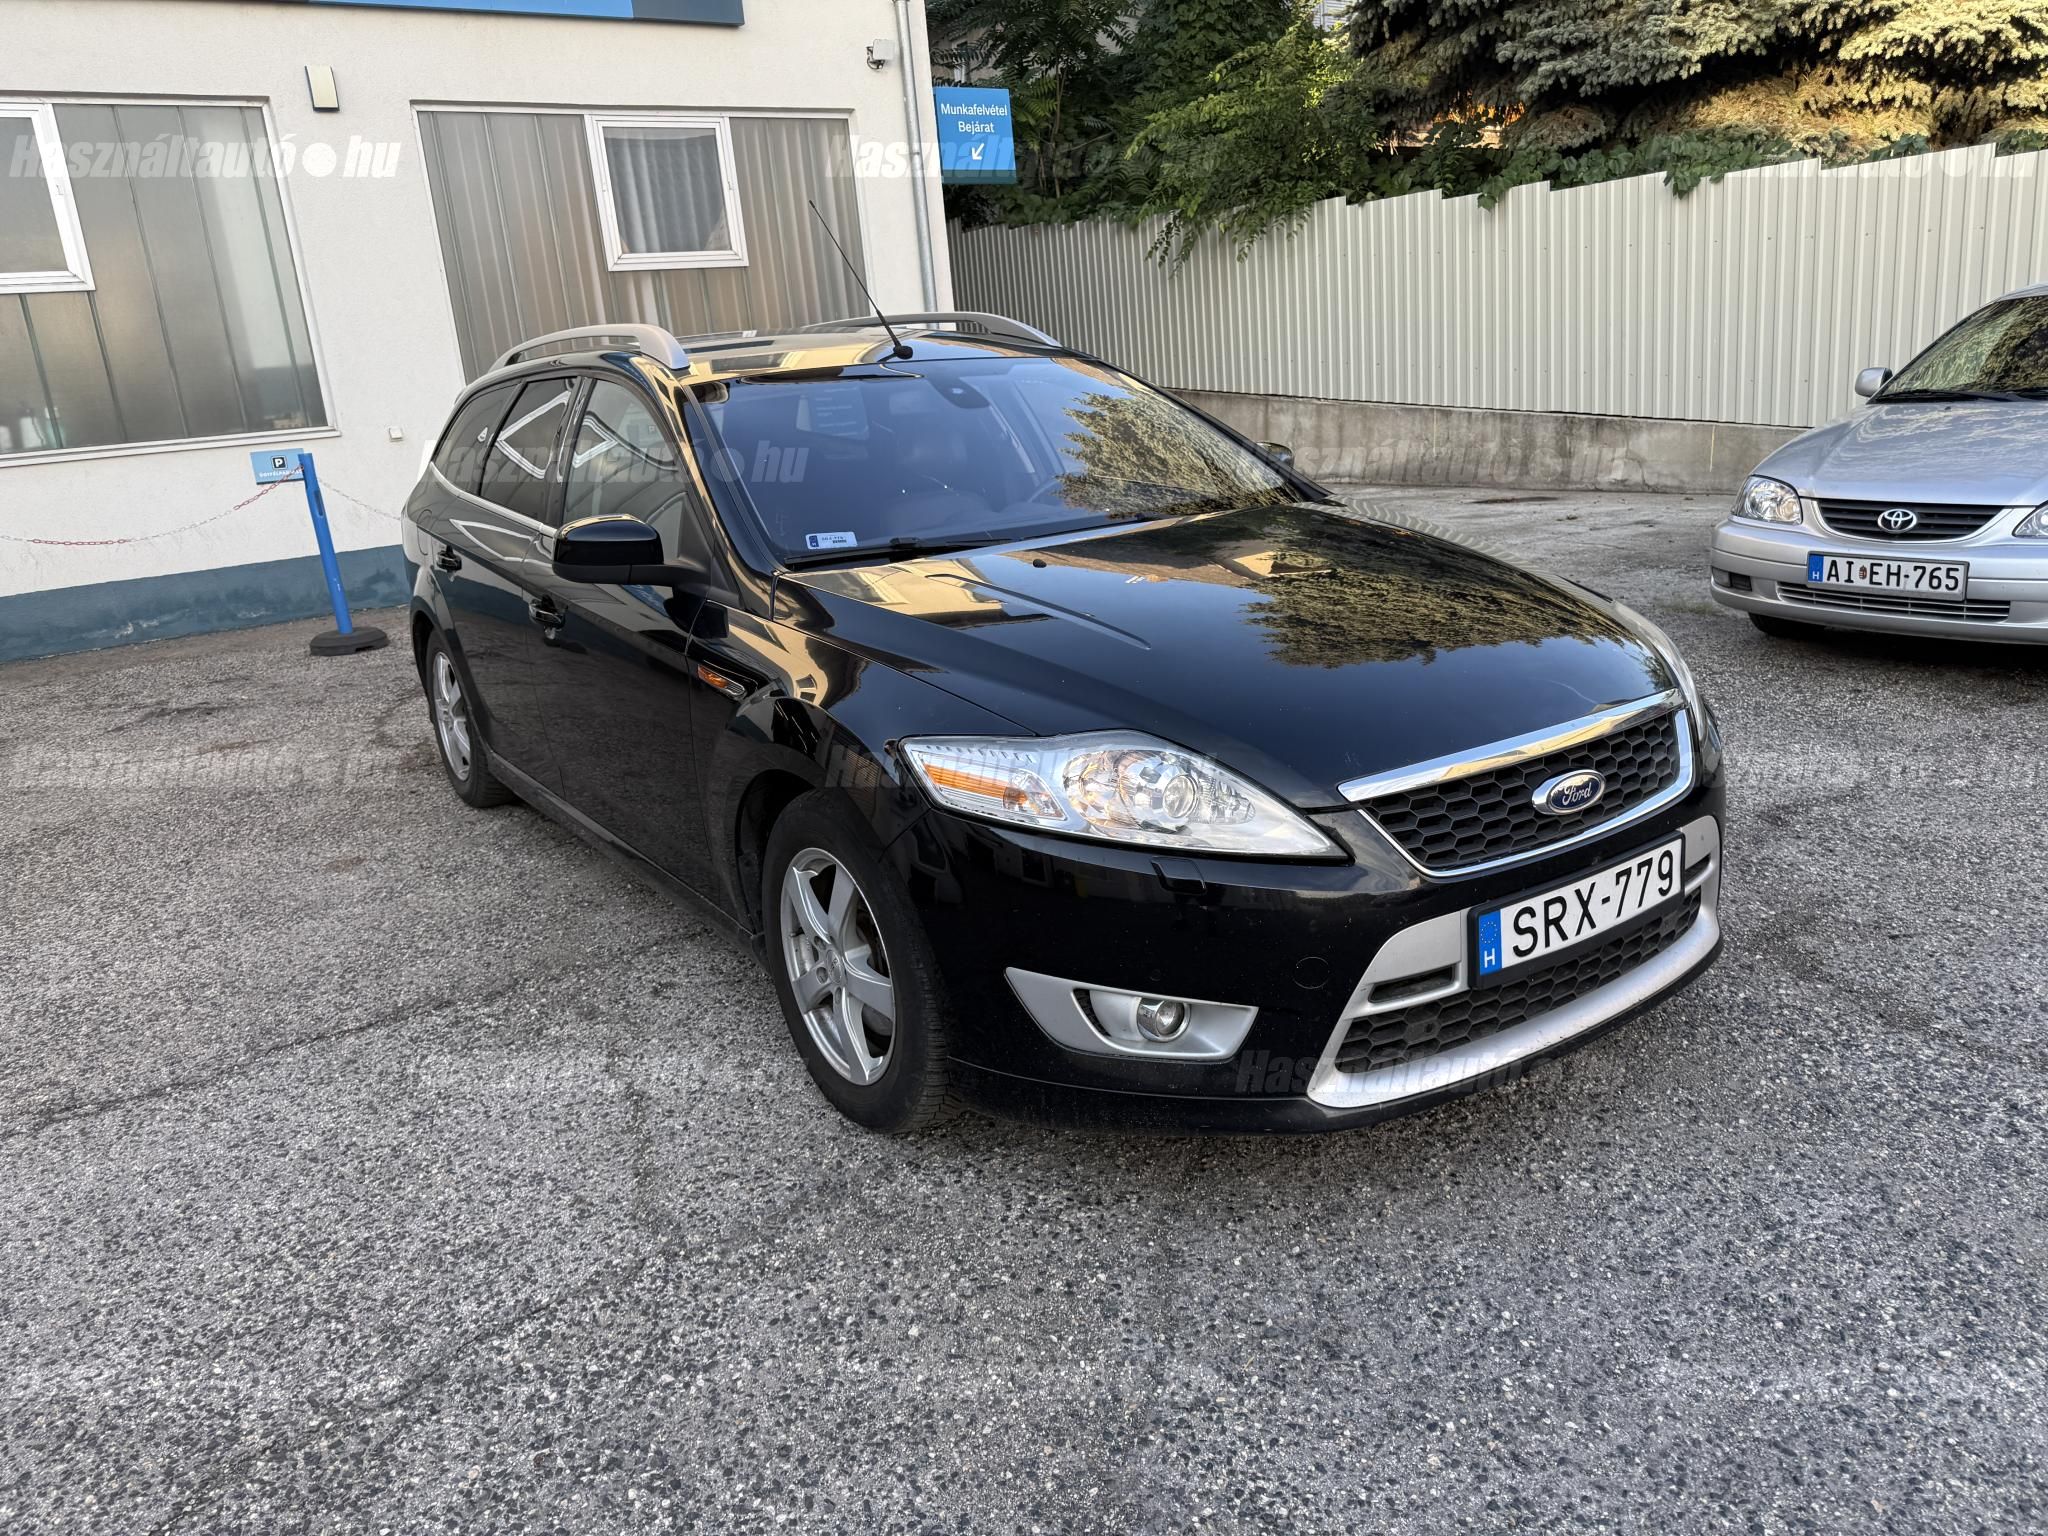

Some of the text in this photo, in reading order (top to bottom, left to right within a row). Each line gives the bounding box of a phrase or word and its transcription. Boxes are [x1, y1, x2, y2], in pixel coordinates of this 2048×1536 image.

[940, 103, 1008, 116] Munkafelvétel
[958, 121, 995, 134] Bejárat
[1812, 571, 1821, 582] H
[1869, 562, 1960, 591] EH-765
[1561, 783, 1593, 805] Ford
[1511, 848, 1675, 959] SRX-779
[1484, 948, 1496, 968] H
